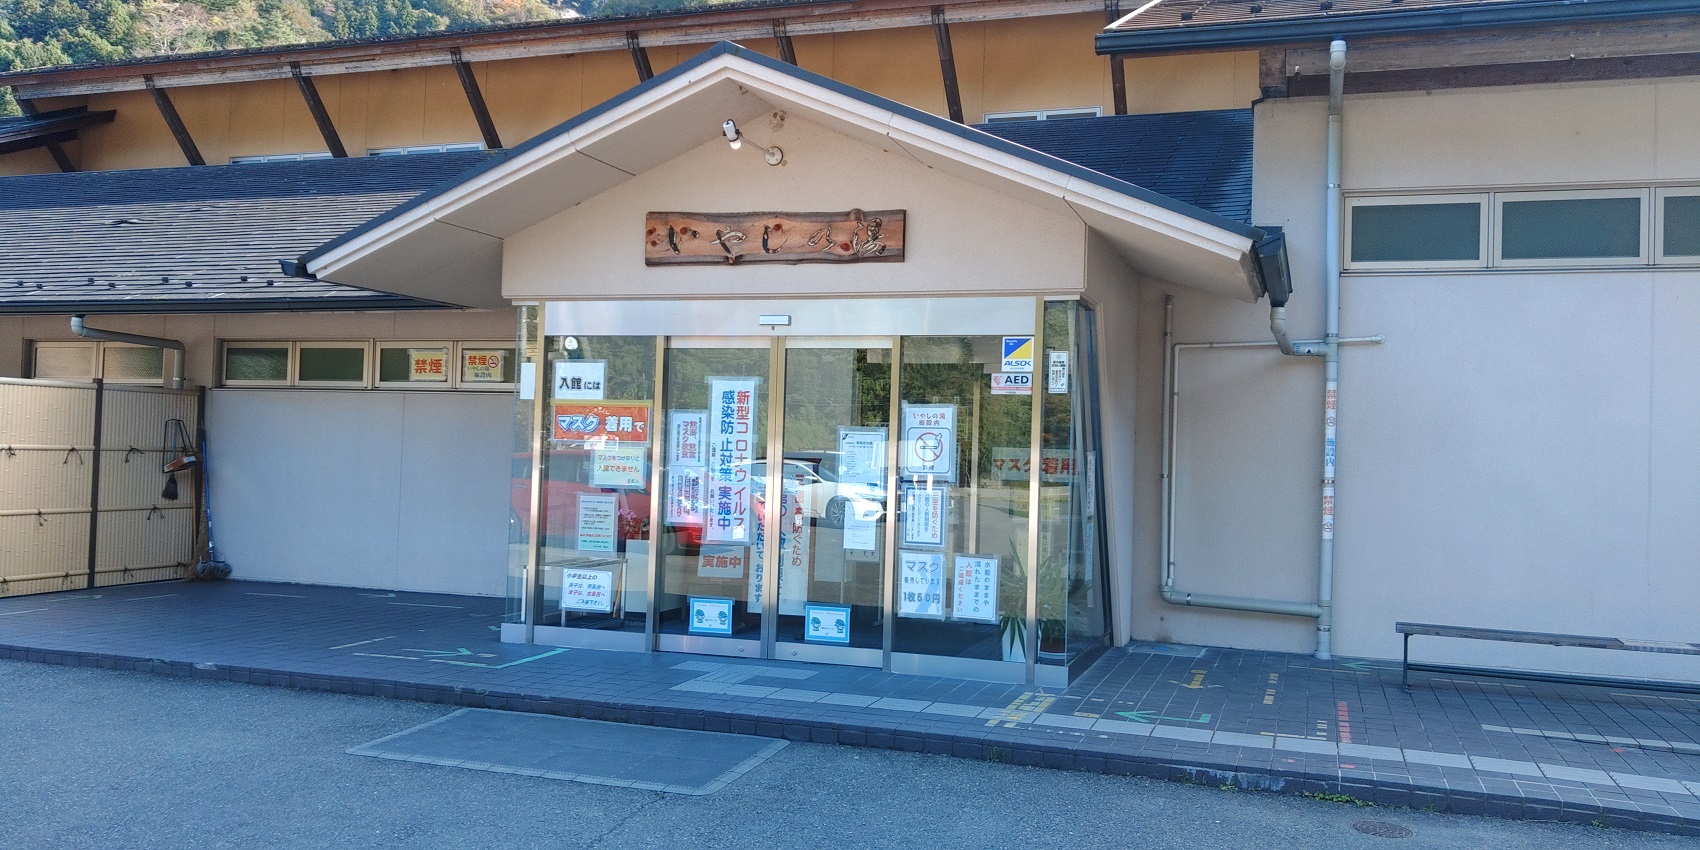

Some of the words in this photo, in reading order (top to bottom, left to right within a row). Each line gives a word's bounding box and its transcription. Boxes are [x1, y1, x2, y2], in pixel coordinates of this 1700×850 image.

[414, 358, 443, 374] 禁煙
[468, 355, 488, 366] 禁煙
[559, 376, 601, 391] 入館には
[1004, 375, 1029, 384] AED
[1327, 389, 1337, 410] 禁煙
[557, 413, 600, 433] マスク
[605, 415, 645, 432] 着用で
[1325, 437, 1335, 467] 施設内
[1323, 495, 1334, 516] 禁煙
[702, 555, 742, 569] 実施中
[906, 561, 940, 572] マスク
[904, 576, 940, 585] 販売しています
[972, 560, 982, 613] 濡れたままでの
[983, 561, 992, 606] 水着のままや
